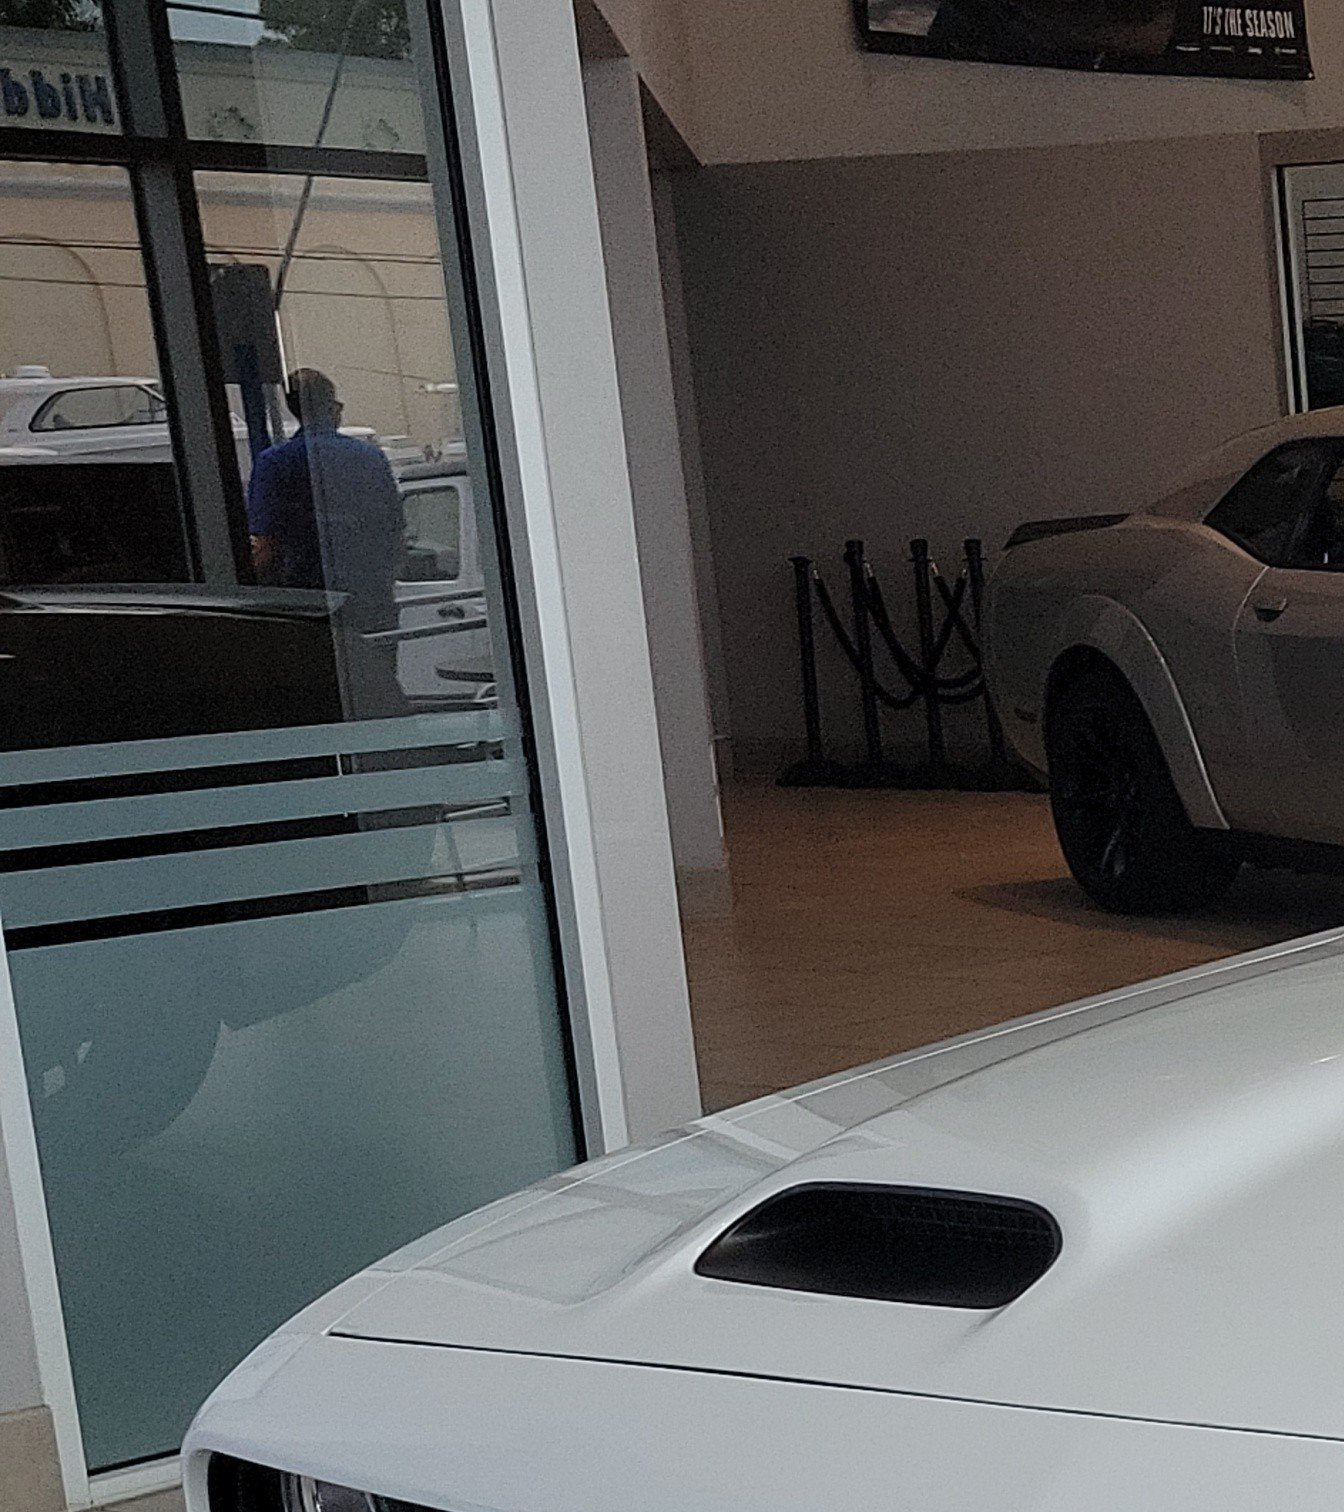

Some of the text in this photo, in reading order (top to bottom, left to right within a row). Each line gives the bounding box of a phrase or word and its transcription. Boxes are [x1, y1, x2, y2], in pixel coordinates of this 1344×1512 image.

[1202, 6, 1296, 38] IT'S THE SEASON
